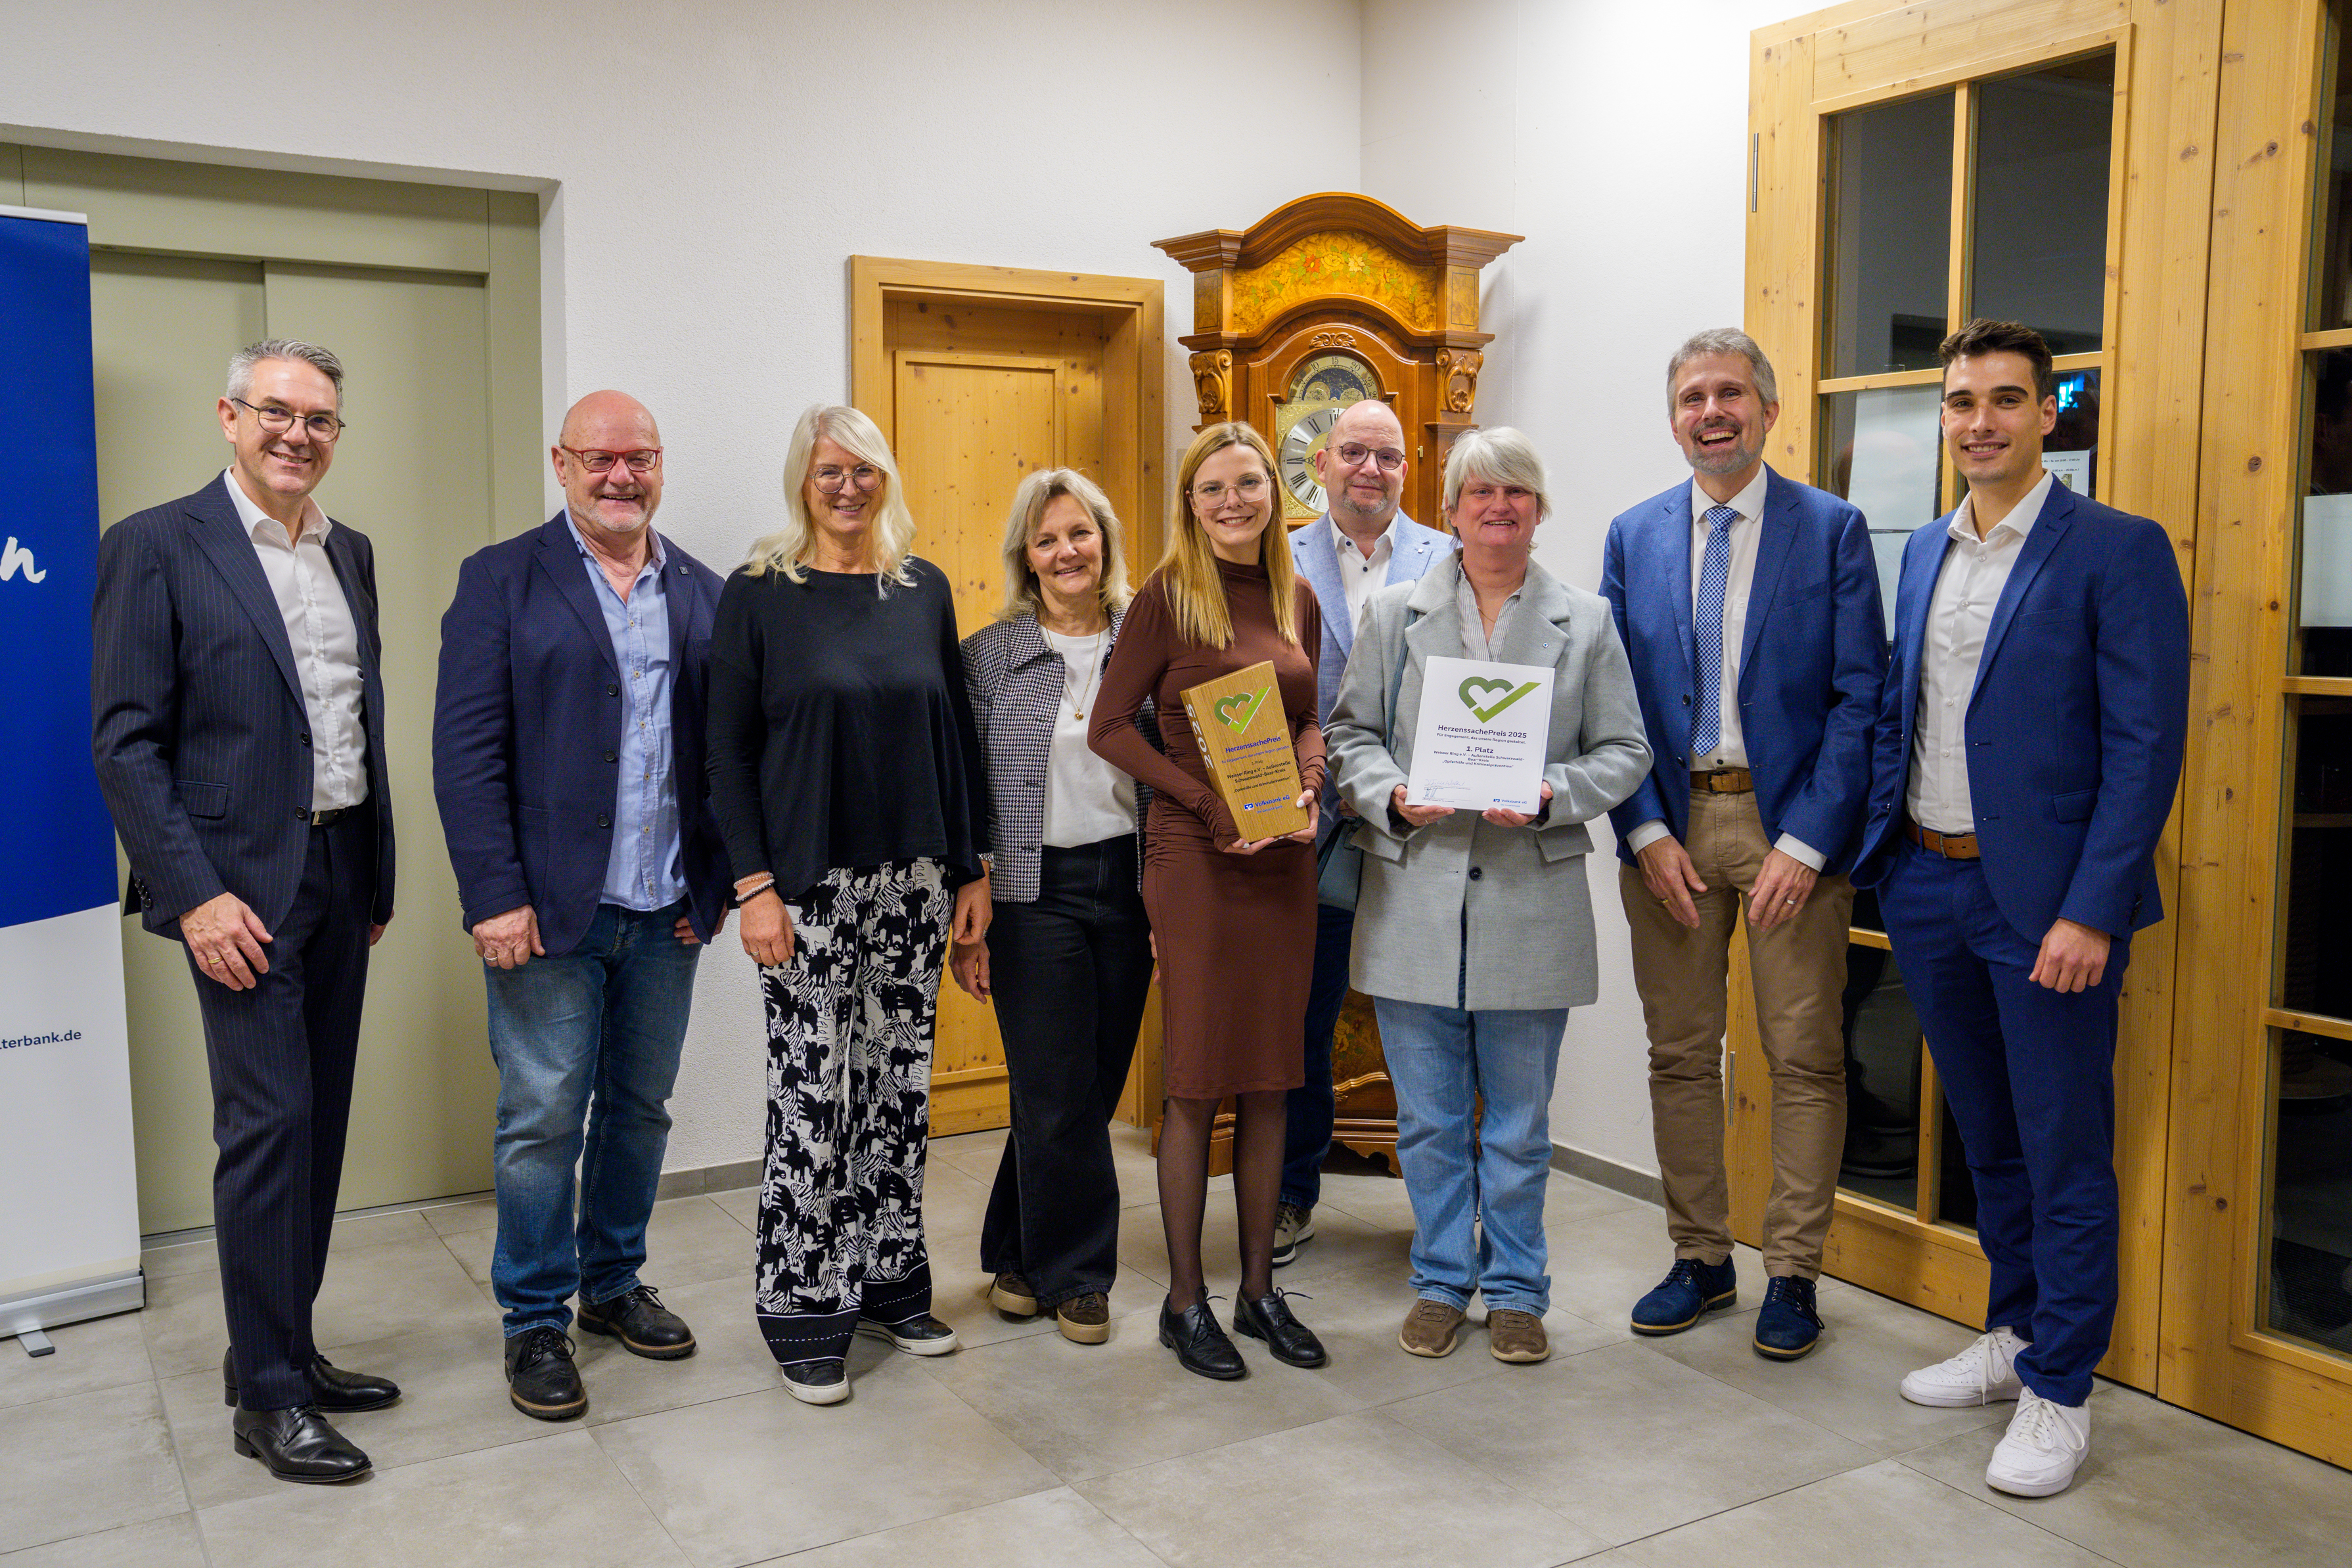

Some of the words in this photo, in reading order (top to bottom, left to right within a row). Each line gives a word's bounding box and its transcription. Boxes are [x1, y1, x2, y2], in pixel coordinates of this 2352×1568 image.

[1311, 362, 1319, 371] 10
[1350, 362, 1361, 371] 20
[1365, 377, 1374, 388] 25
[1186, 704, 1214, 769] 2025
[1438, 725, 1506, 737] HerzenssachePreis
[1226, 736, 1281, 753] HerzenssachePreis
[1266, 761, 1291, 769] Außenstelle
[1235, 768, 1286, 783] Schwarzwald-Baar-Kreis
[1255, 797, 1281, 807] Volksbank
